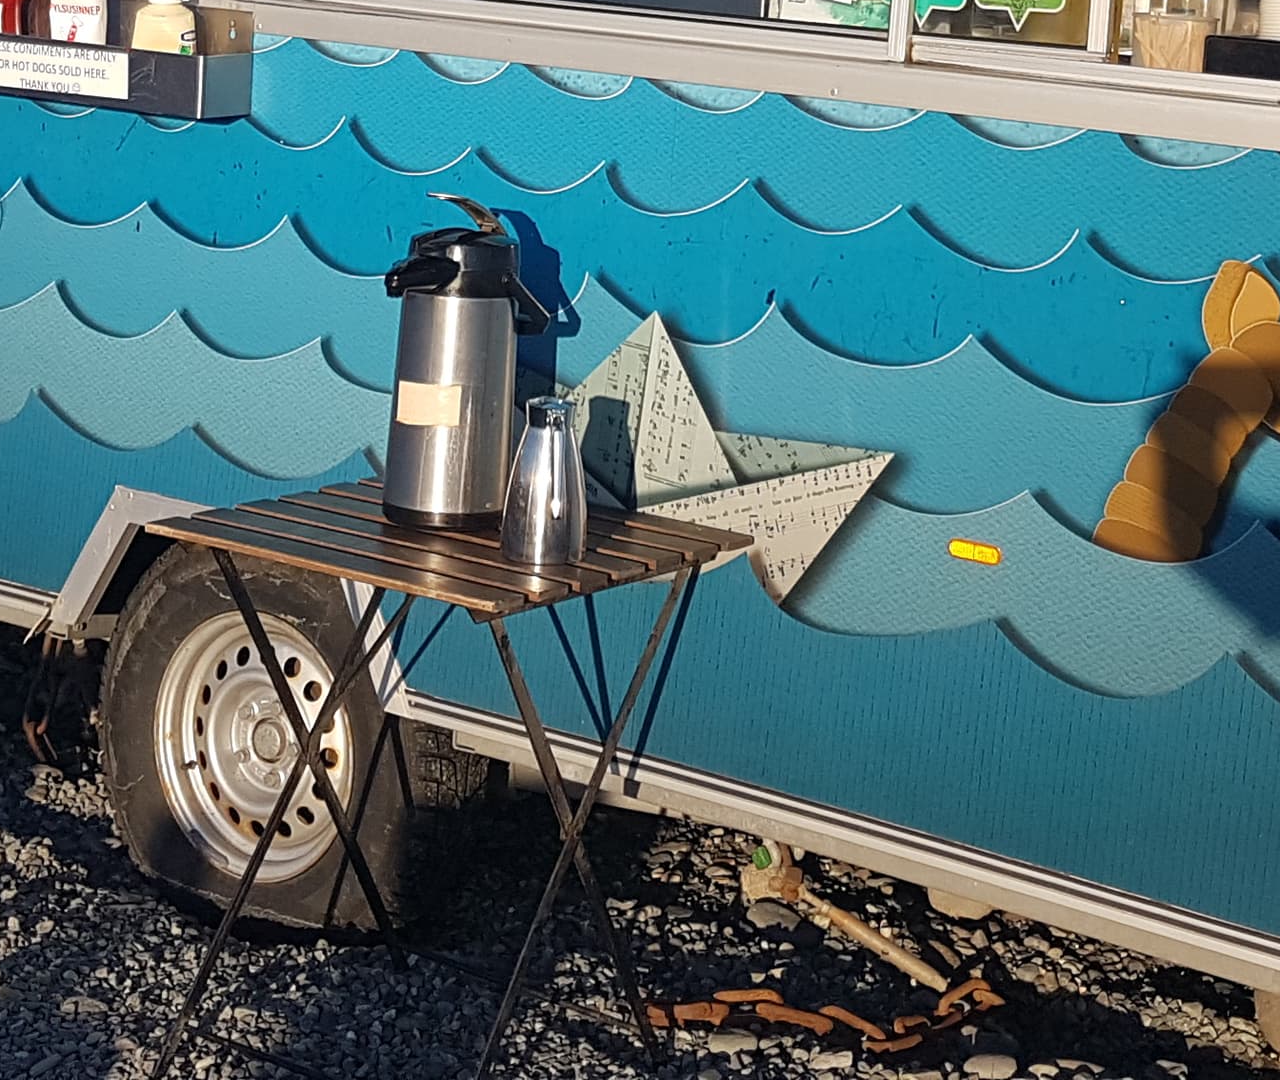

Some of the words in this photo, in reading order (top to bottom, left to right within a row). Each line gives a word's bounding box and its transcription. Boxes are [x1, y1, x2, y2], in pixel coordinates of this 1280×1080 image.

[13, 42, 71, 59] CONDIMENTS
[73, 48, 91, 61] ARE
[93, 50, 117, 63] ONLY
[12, 59, 30, 71] HOT
[32, 62, 57, 74] DOGS
[58, 65, 81, 77] SOLD
[19, 78, 49, 91] THANK
[51, 81, 70, 93] YOU
